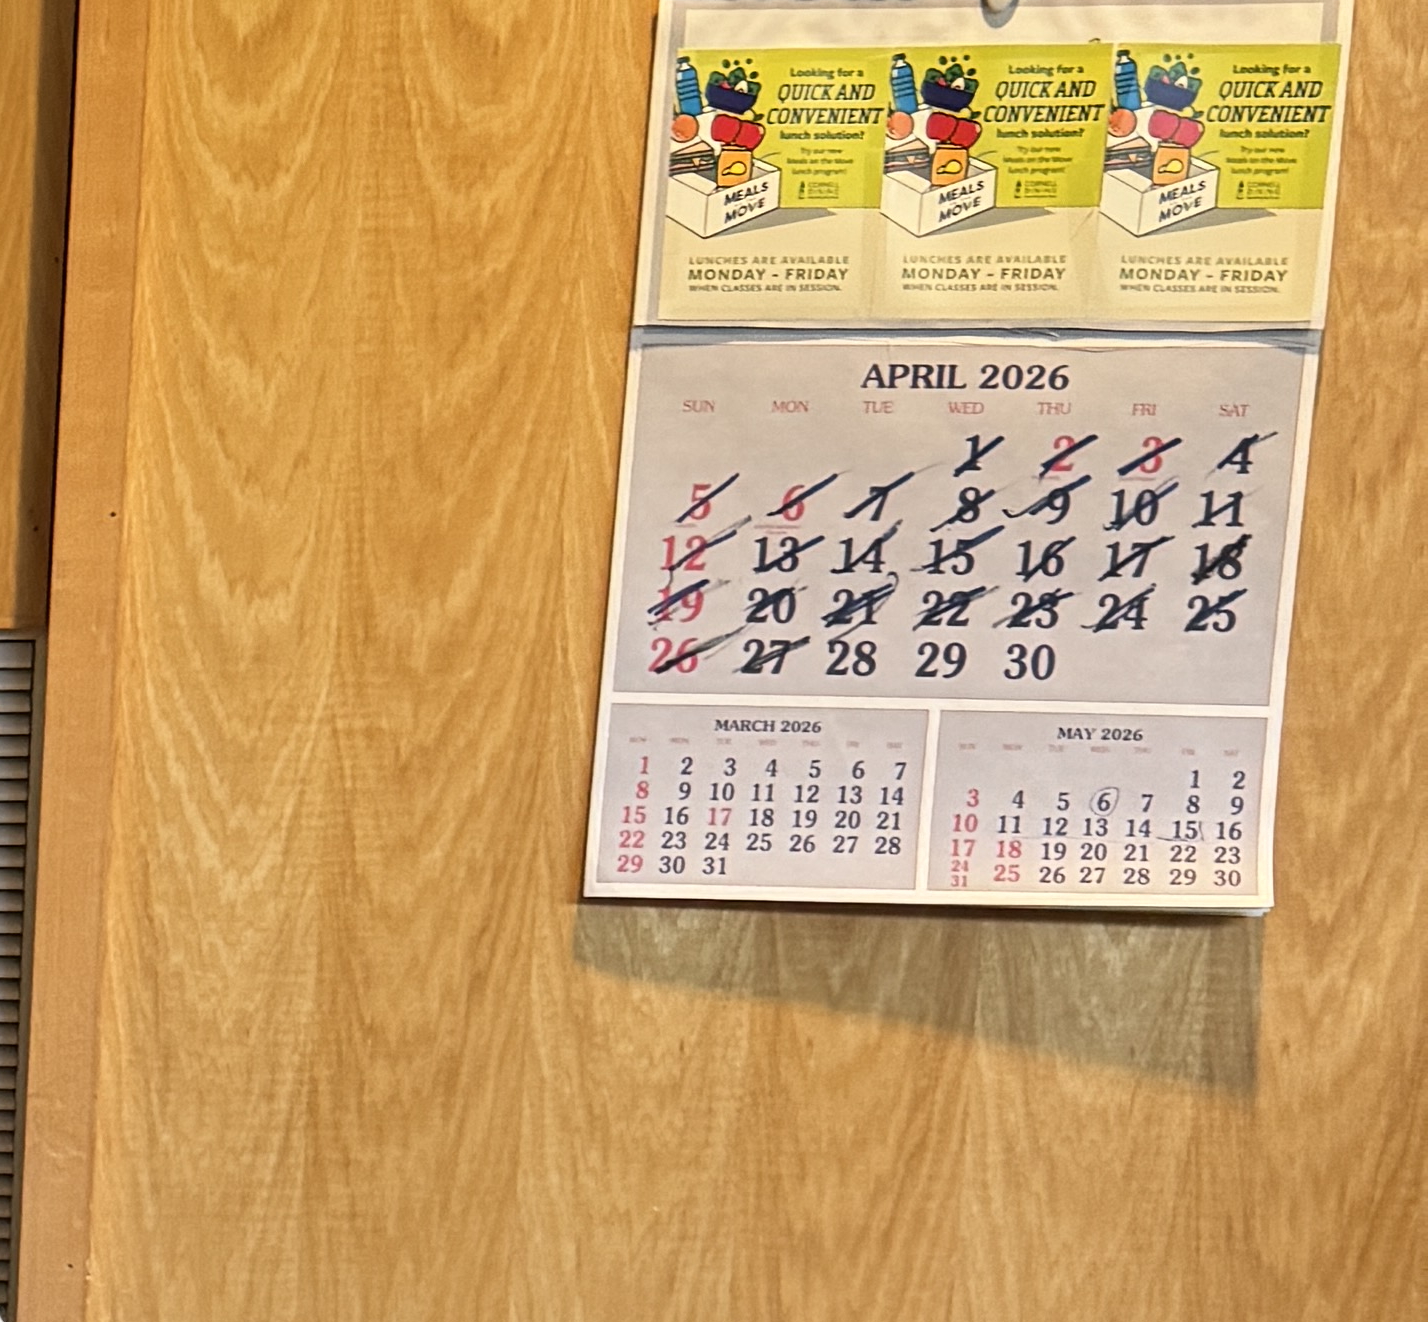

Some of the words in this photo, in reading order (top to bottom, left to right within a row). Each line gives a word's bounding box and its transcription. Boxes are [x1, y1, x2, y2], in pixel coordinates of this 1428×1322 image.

[789, 68, 836, 80] Looking
[836, 67, 856, 78] for
[777, 84, 832, 103] QUICK
[834, 84, 876, 100] AND
[766, 107, 885, 125] CONVENIENT
[779, 130, 812, 140] lunch
[813, 130, 866, 140] solution?
[724, 181, 769, 206] MEALS
[724, 197, 766, 223] MOVE
[688, 256, 749, 265] LUNCHES
[751, 256, 777, 265] ARE
[779, 255, 850, 265] AVAILABLE
[687, 268, 767, 281] MONDAY
[784, 268, 850, 281] FRIDAY
[860, 363, 968, 390] APRIL
[978, 364, 1070, 390] 2026
[682, 400, 715, 414] SUN
[771, 400, 809, 414] MON
[863, 400, 893, 414] TUE
[948, 401, 985, 416] WED
[1037, 402, 1072, 416] THU
[1132, 403, 1157, 417] FRI
[1219, 404, 1250, 418] SAT
[826, 640, 877, 677] 28
[915, 642, 968, 680] 29
[1003, 643, 1056, 681] 30
[714, 719, 776, 734] MARCH
[779, 720, 822, 733] 2026
[1057, 727, 1097, 742] MAY
[1100, 728, 1144, 742] 2026
